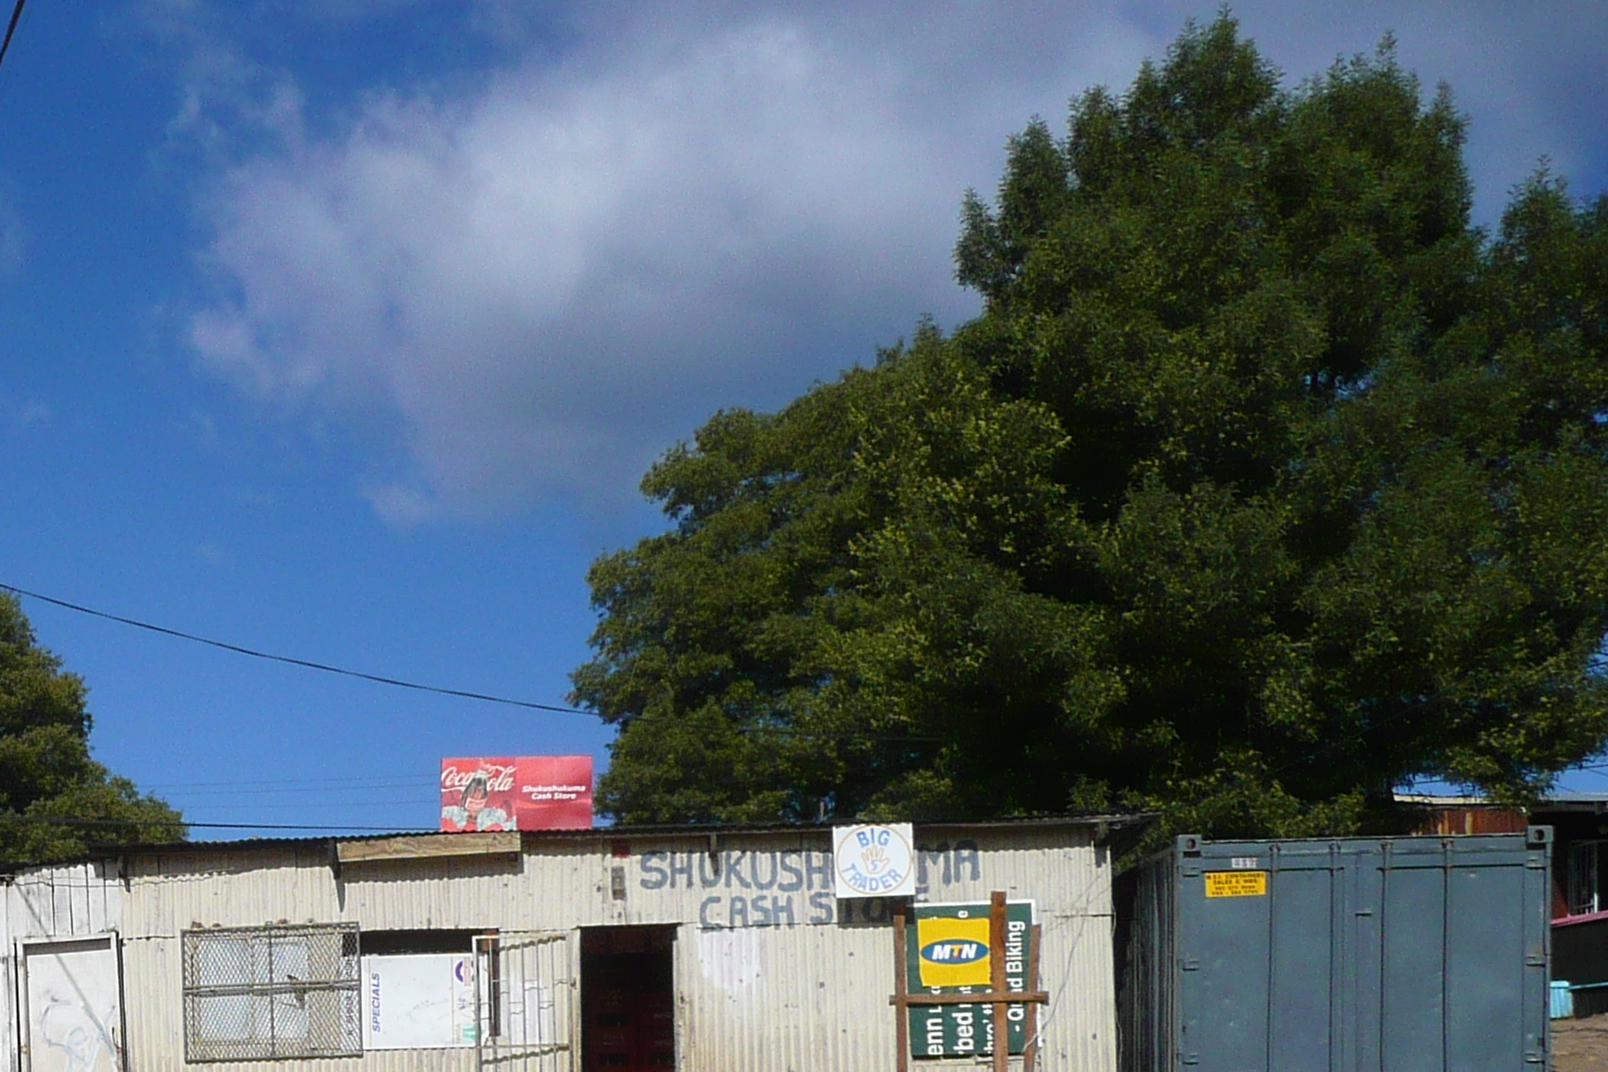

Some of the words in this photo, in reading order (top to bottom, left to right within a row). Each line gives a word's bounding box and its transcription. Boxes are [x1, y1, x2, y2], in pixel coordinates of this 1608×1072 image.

[531, 792, 552, 800] Cash
[553, 792, 577, 800] Store
[856, 828, 891, 848] BIG
[640, 839, 981, 891] SHUKUSHMA
[841, 863, 903, 892] TRADER
[699, 894, 794, 929] CASH
[932, 943, 978, 960] MTN
[1006, 920, 1026, 973] Biking
[371, 972, 381, 1033] SPECIALS
